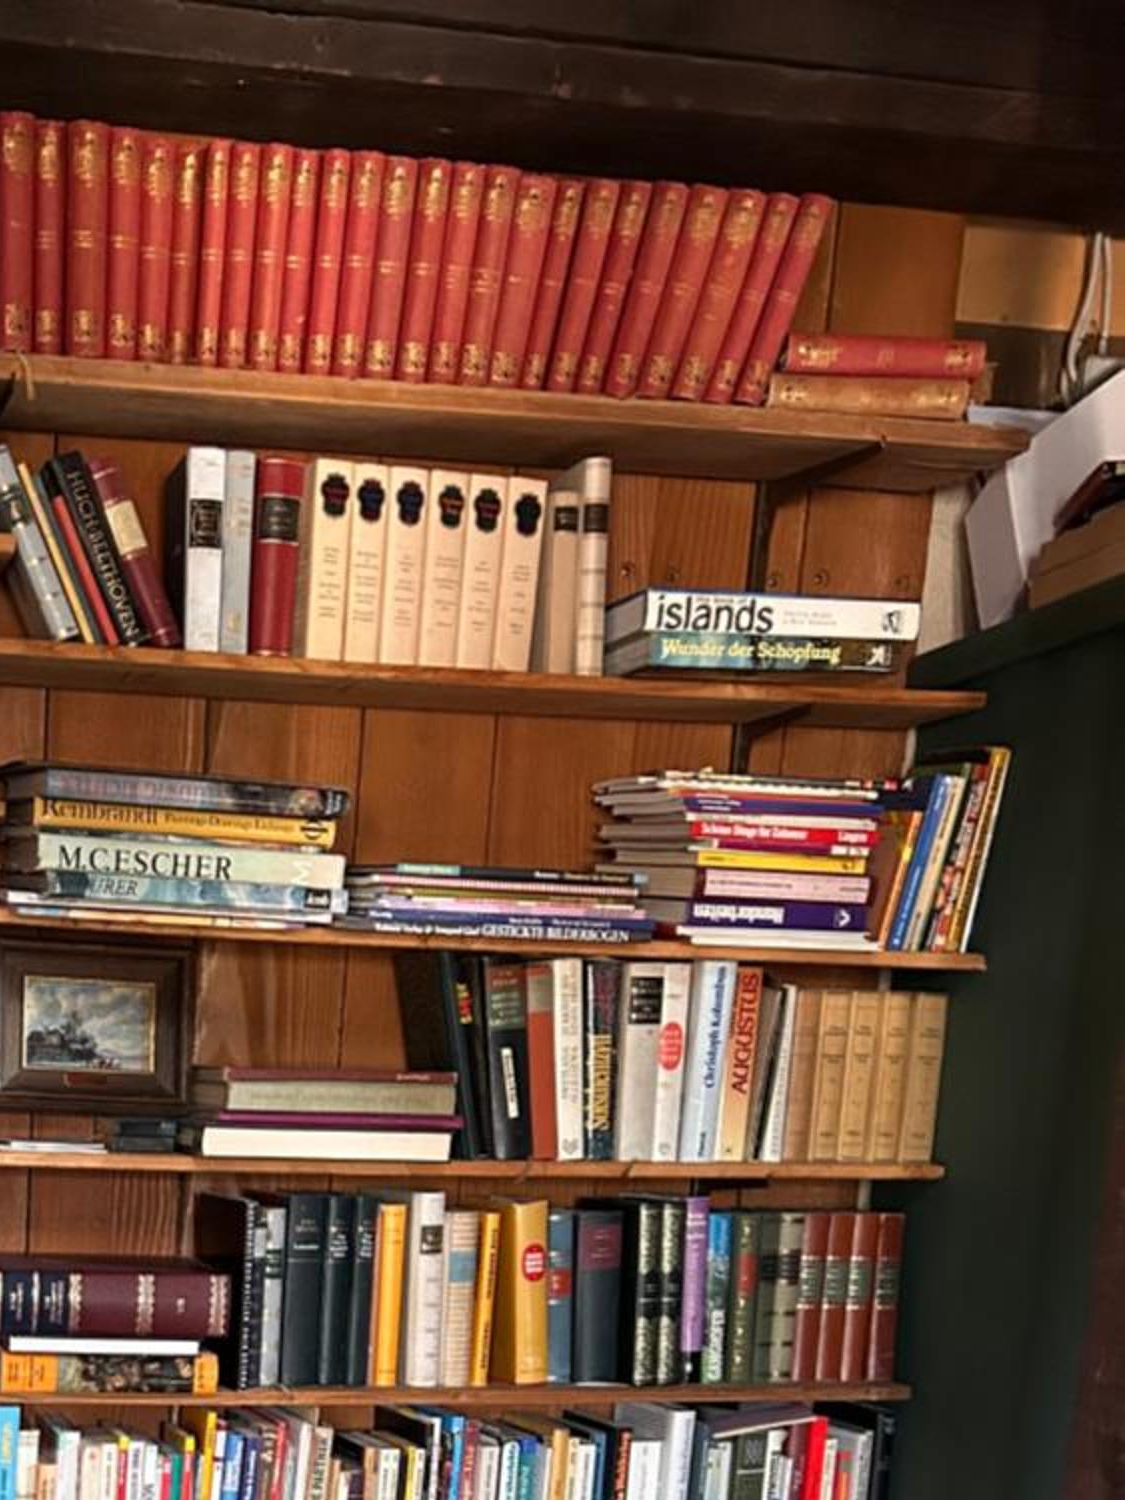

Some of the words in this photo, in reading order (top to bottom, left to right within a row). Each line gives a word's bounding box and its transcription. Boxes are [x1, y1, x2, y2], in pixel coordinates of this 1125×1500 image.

[656, 594, 775, 634] islands
[727, 639, 754, 658] der
[731, 971, 760, 1095] AUGUSTUS
